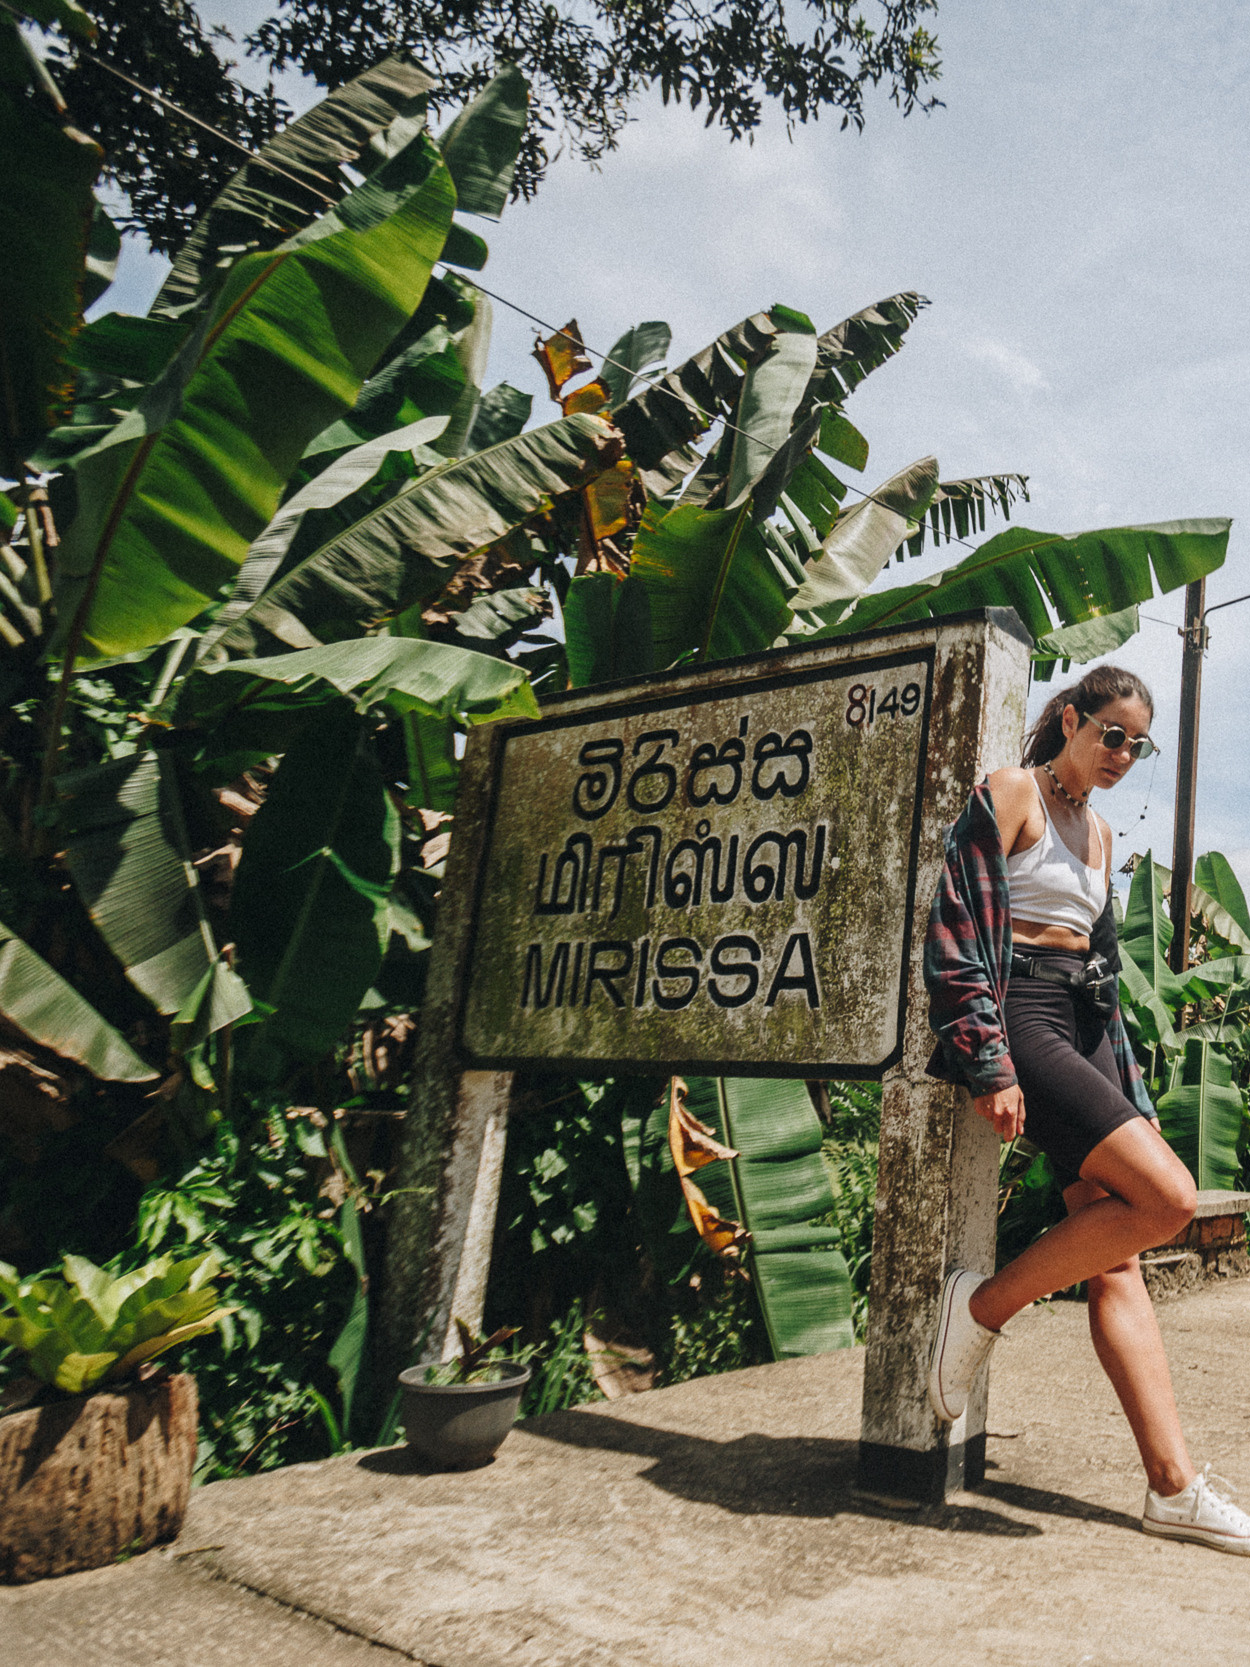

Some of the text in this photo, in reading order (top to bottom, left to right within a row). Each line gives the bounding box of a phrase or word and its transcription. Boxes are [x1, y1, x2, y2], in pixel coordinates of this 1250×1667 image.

[845, 682, 921, 727] 8149
[572, 715, 813, 820] මිරිස්ස
[534, 819, 826, 921] மிரிஸ்ஸ
[521, 932, 820, 1010] MIRISSA
